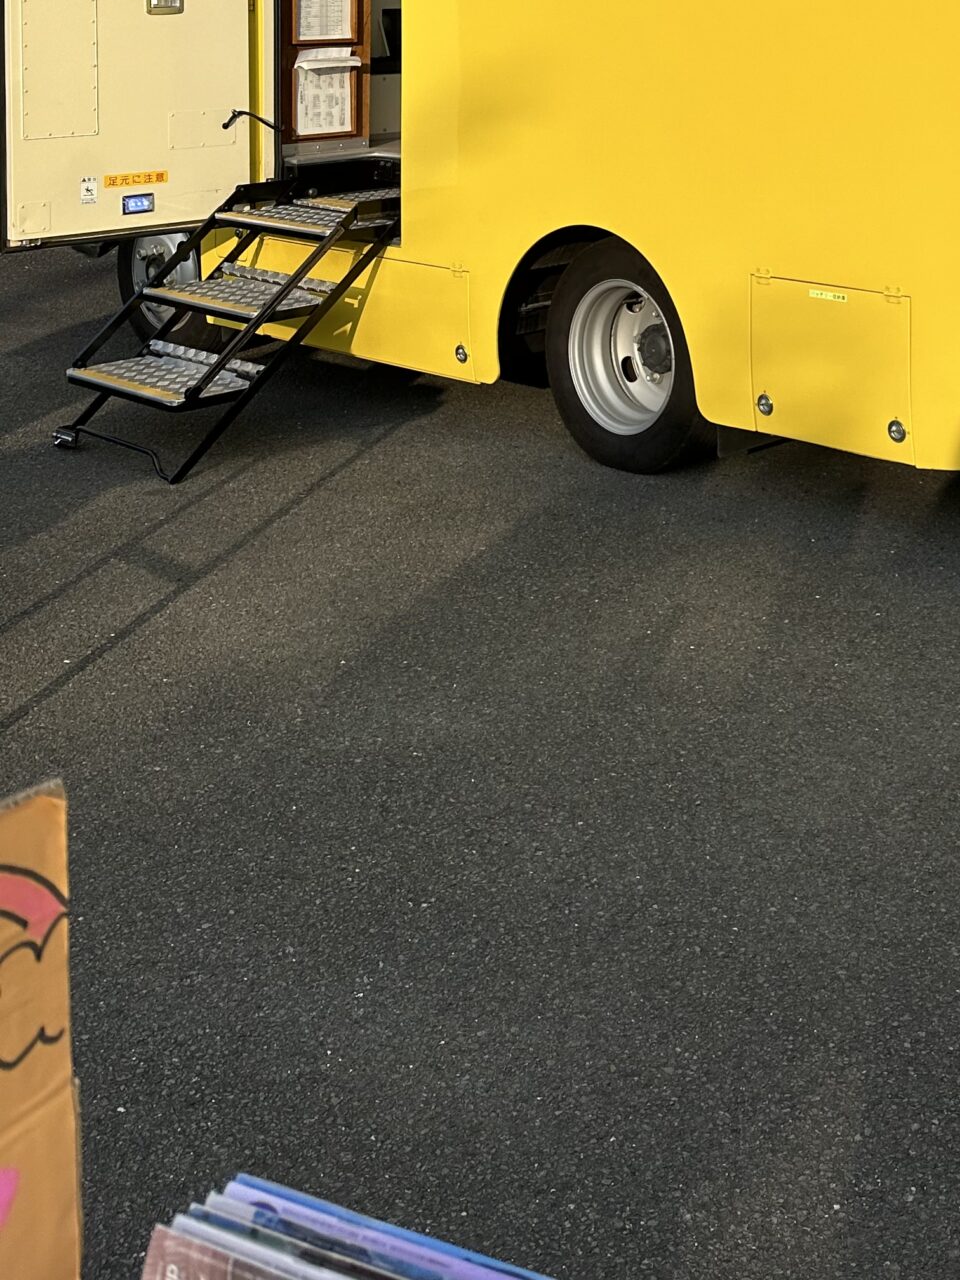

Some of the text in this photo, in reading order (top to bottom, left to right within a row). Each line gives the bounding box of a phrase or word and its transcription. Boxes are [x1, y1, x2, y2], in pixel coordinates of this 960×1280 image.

[107, 172, 166, 187] 足元に注意
